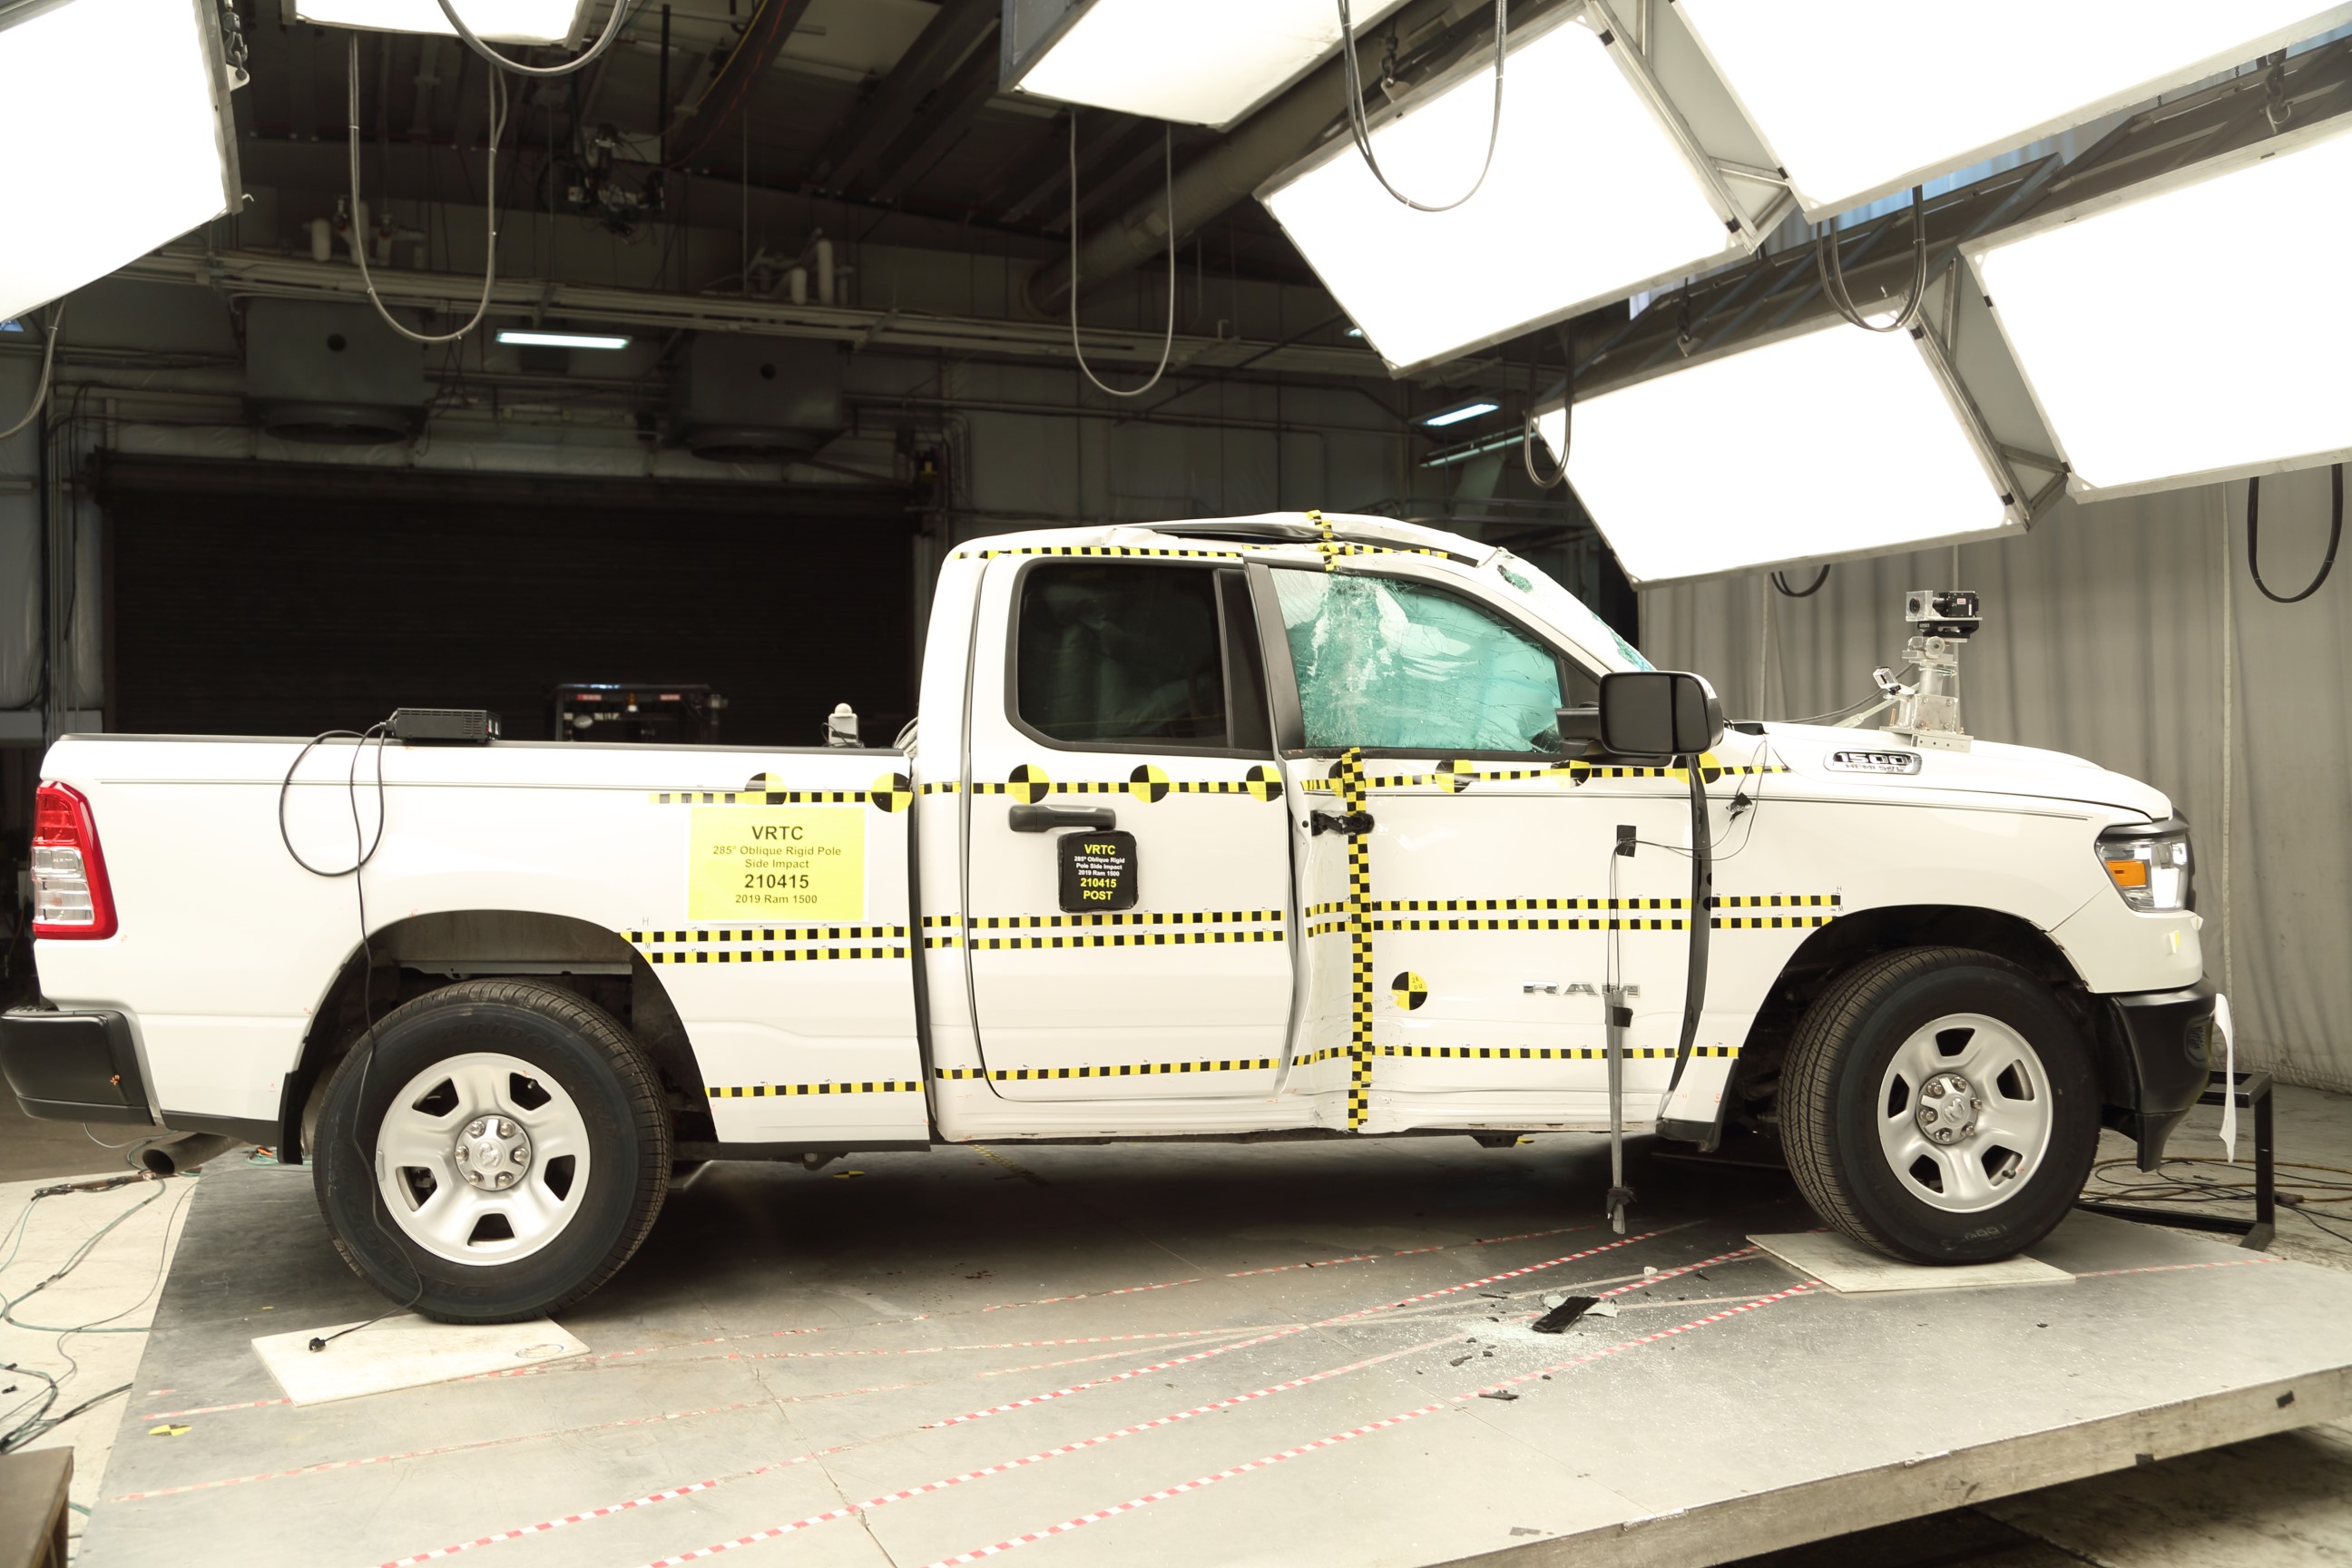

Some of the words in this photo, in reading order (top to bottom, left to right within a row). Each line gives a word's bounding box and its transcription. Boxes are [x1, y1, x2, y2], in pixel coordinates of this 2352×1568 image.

[1837, 752, 1909, 765] 1500
[752, 826, 804, 840] VRTC
[740, 846, 782, 856] Oblique
[786, 847, 814, 857] Rigid
[818, 847, 841, 856] Pole
[1084, 844, 1116, 855] VRTC
[745, 859, 769, 868] Side
[772, 859, 809, 869] Impact
[745, 874, 809, 888] 210415
[1081, 877, 1117, 887] 210415
[735, 895, 760, 903] 2019
[764, 895, 789, 904] Ram
[793, 895, 818, 904] 1500
[1083, 890, 1112, 900] POST
